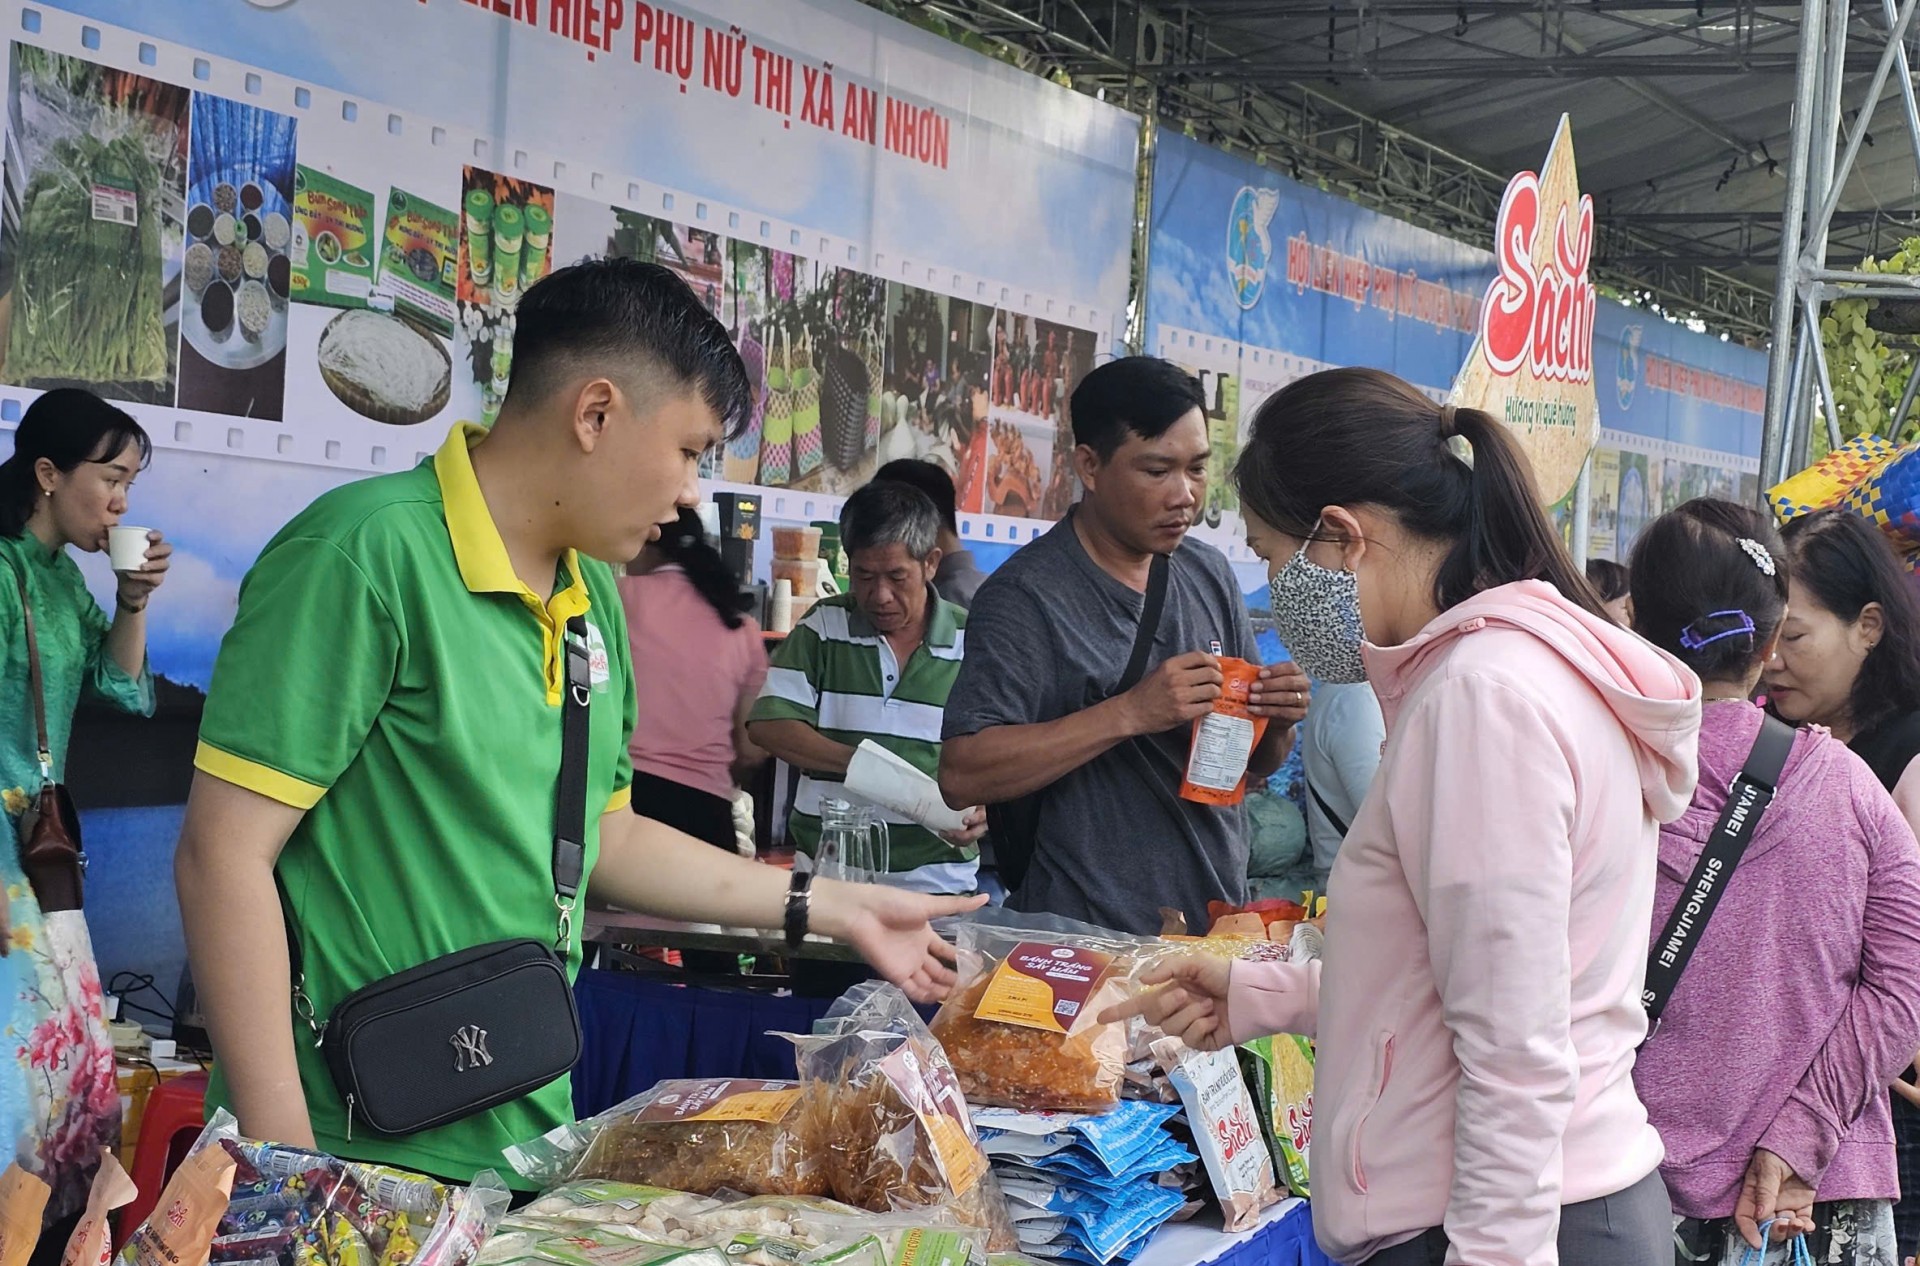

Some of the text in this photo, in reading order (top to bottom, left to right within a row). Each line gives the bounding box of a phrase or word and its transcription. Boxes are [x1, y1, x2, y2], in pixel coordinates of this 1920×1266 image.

[633, 1, 694, 93] PHỤ
[703, 25, 746, 97] NỮ
[752, 45, 793, 129] THỊ
[800, 61, 834, 131] XÃ
[842, 81, 878, 145] AN
[885, 96, 949, 169] NHƠN
[1658, 857, 1723, 969] SHENGJIAMEI
